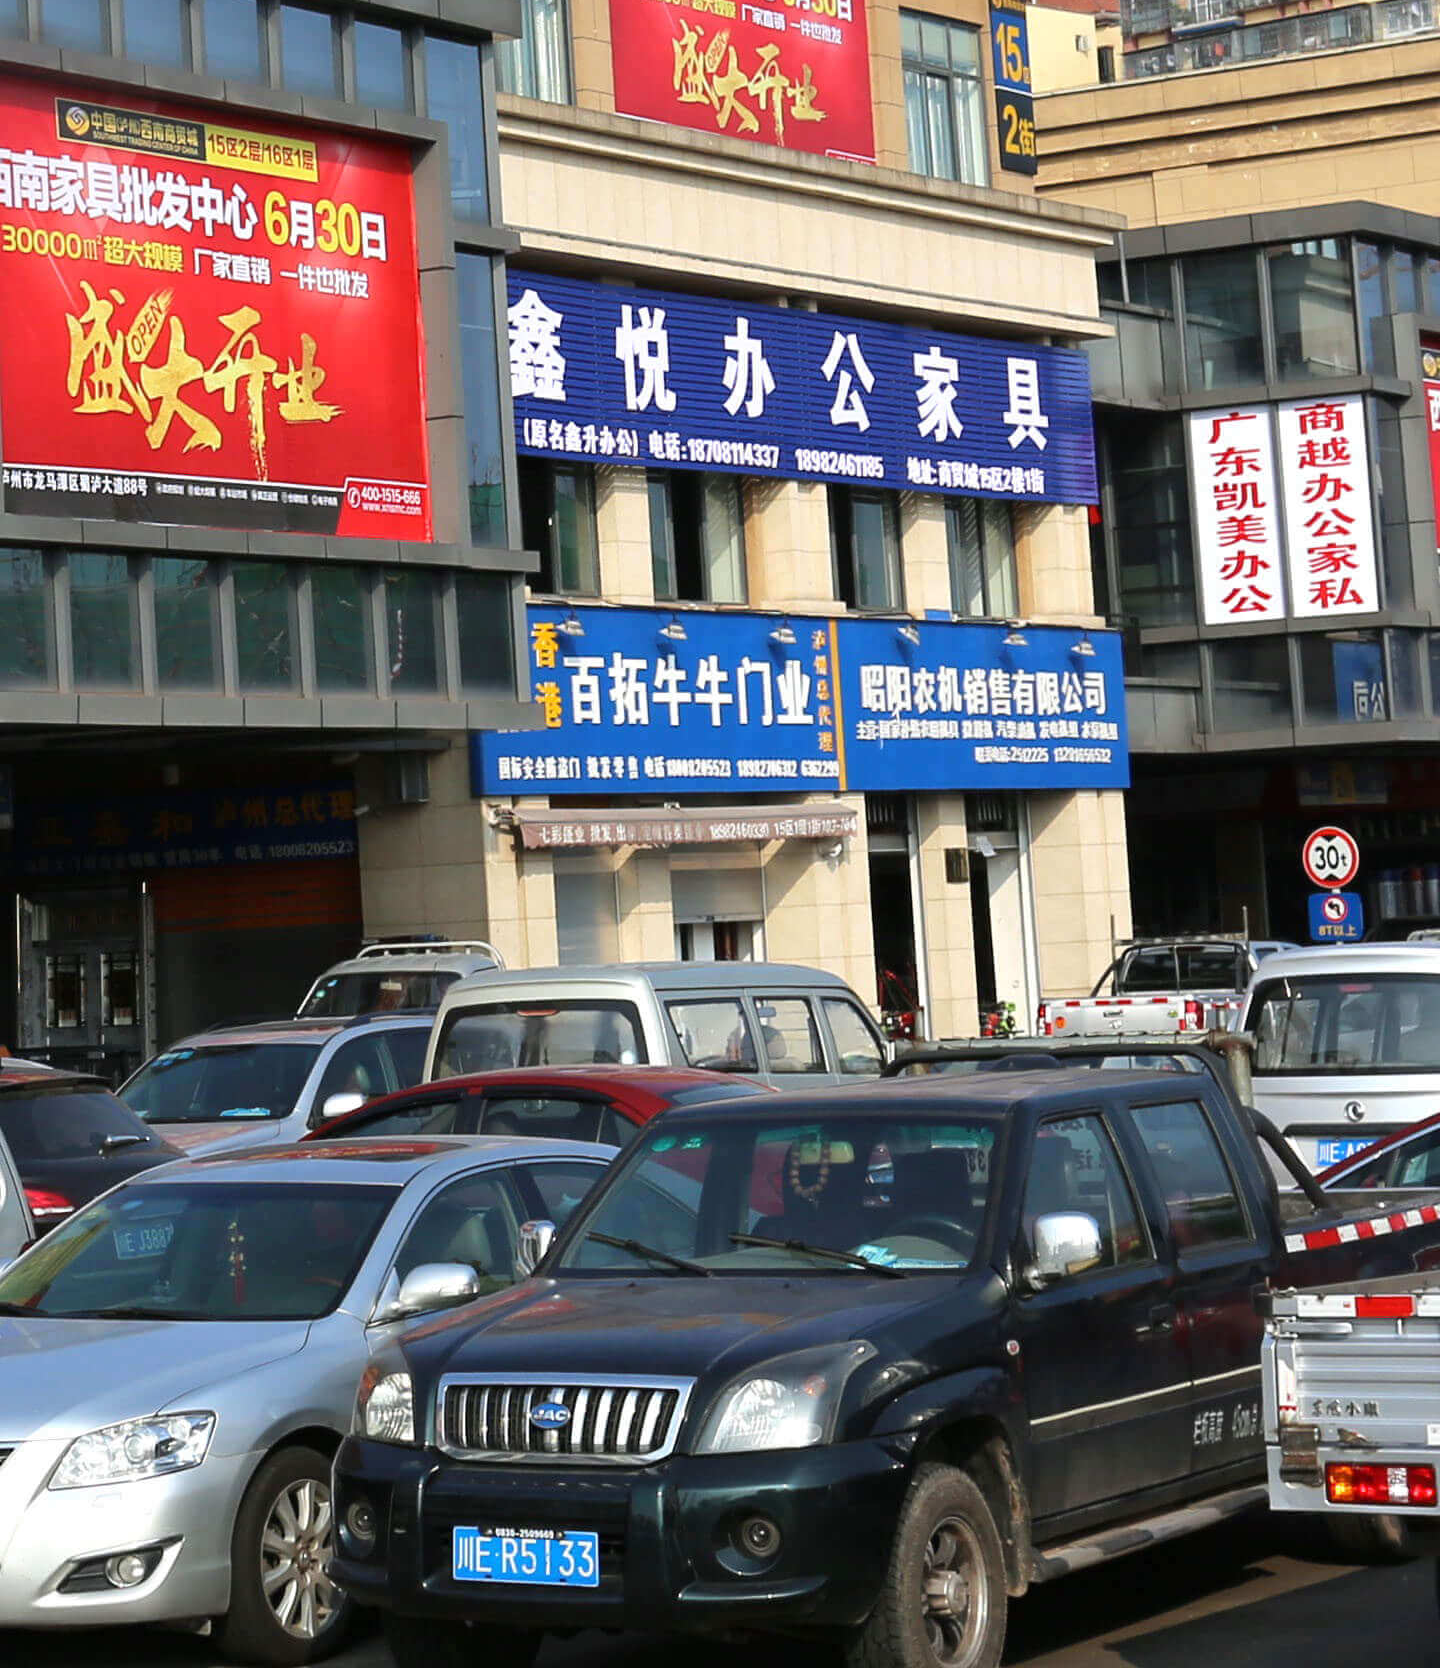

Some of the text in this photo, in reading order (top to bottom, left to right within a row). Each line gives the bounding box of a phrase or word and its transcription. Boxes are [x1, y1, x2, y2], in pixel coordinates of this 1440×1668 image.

[207, 134, 315, 170] 15区2层/16区1层
[1003, 104, 1034, 156] 2街
[264, 191, 388, 262] 6月30日
[193, 248, 271, 285] 厂家直销
[281, 263, 369, 299] 一件也批发
[130, 297, 167, 356] OPEN
[65, 281, 346, 481] 盛大开业
[507, 288, 1049, 451] 鑫悦办公家具
[1208, 410, 1273, 615] 广东凯美办公
[1296, 402, 1364, 610] 商越办公家私
[532, 622, 562, 729] 香港
[563, 652, 814, 727] 百拓牛牛门业
[860, 665, 1106, 716] 昭阳农机销售有限公司
[533, 1409, 568, 1422] JAC
